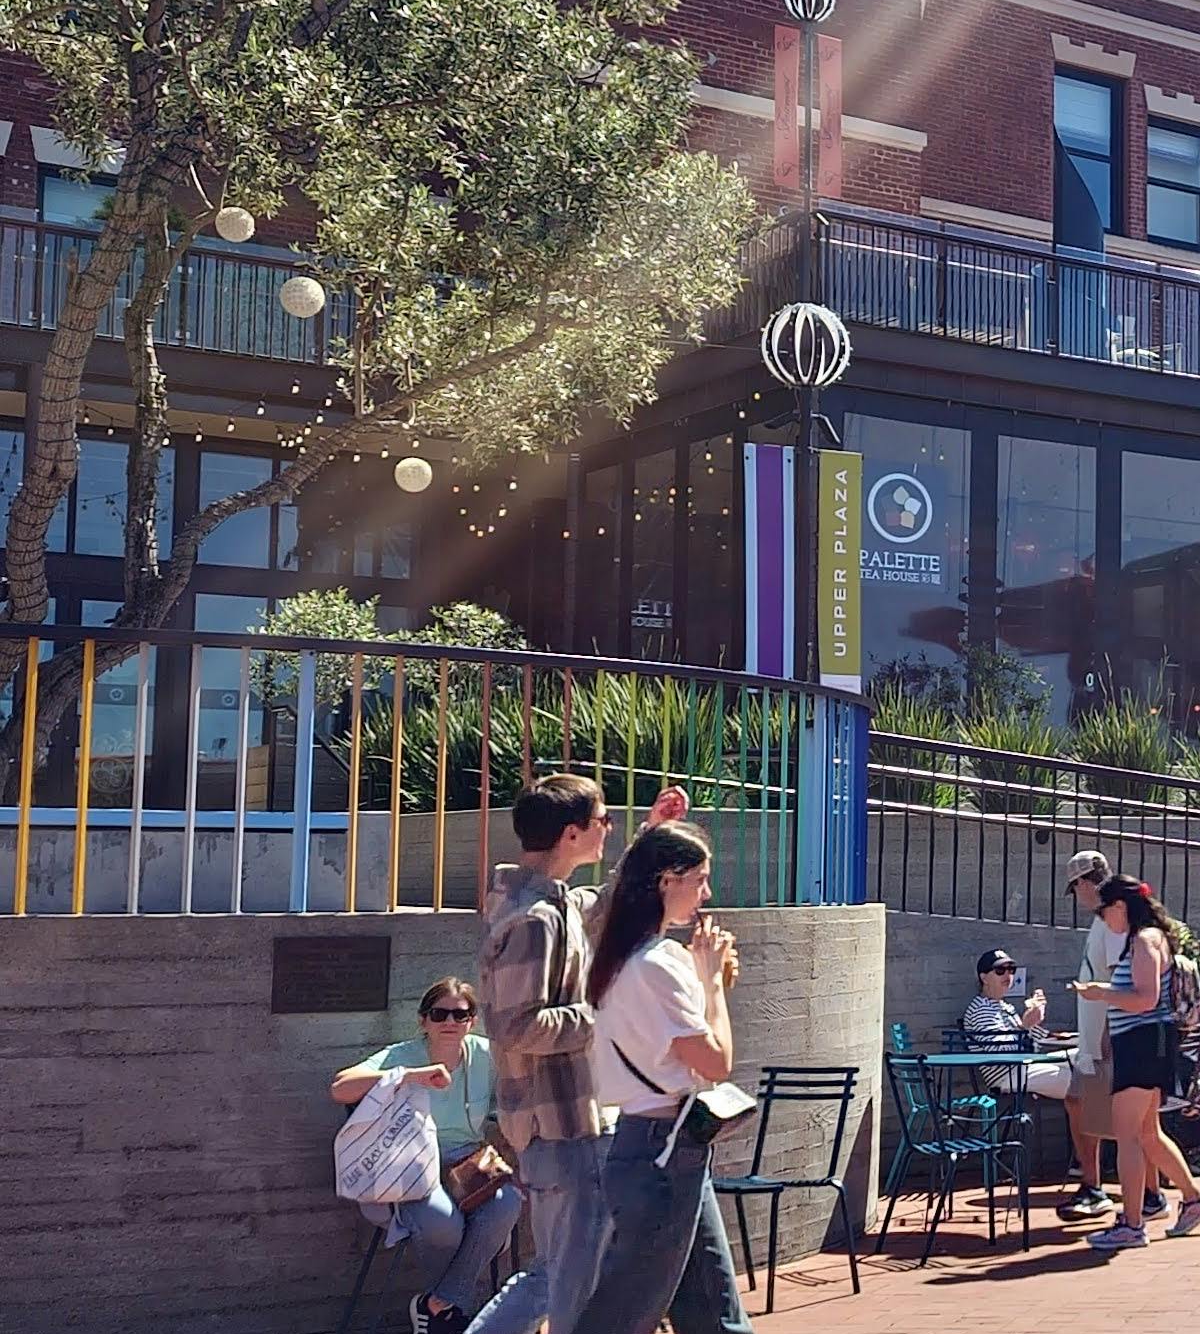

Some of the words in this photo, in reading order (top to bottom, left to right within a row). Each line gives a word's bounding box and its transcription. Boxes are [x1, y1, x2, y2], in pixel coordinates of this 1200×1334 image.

[834, 469, 848, 554] PLAZA
[859, 549, 940, 572] PALETTE
[860, 568, 880, 580] TEA
[883, 570, 919, 583] HOUSE
[833, 569, 847, 657] UPPER
[361, 1147, 384, 1172] BAY
